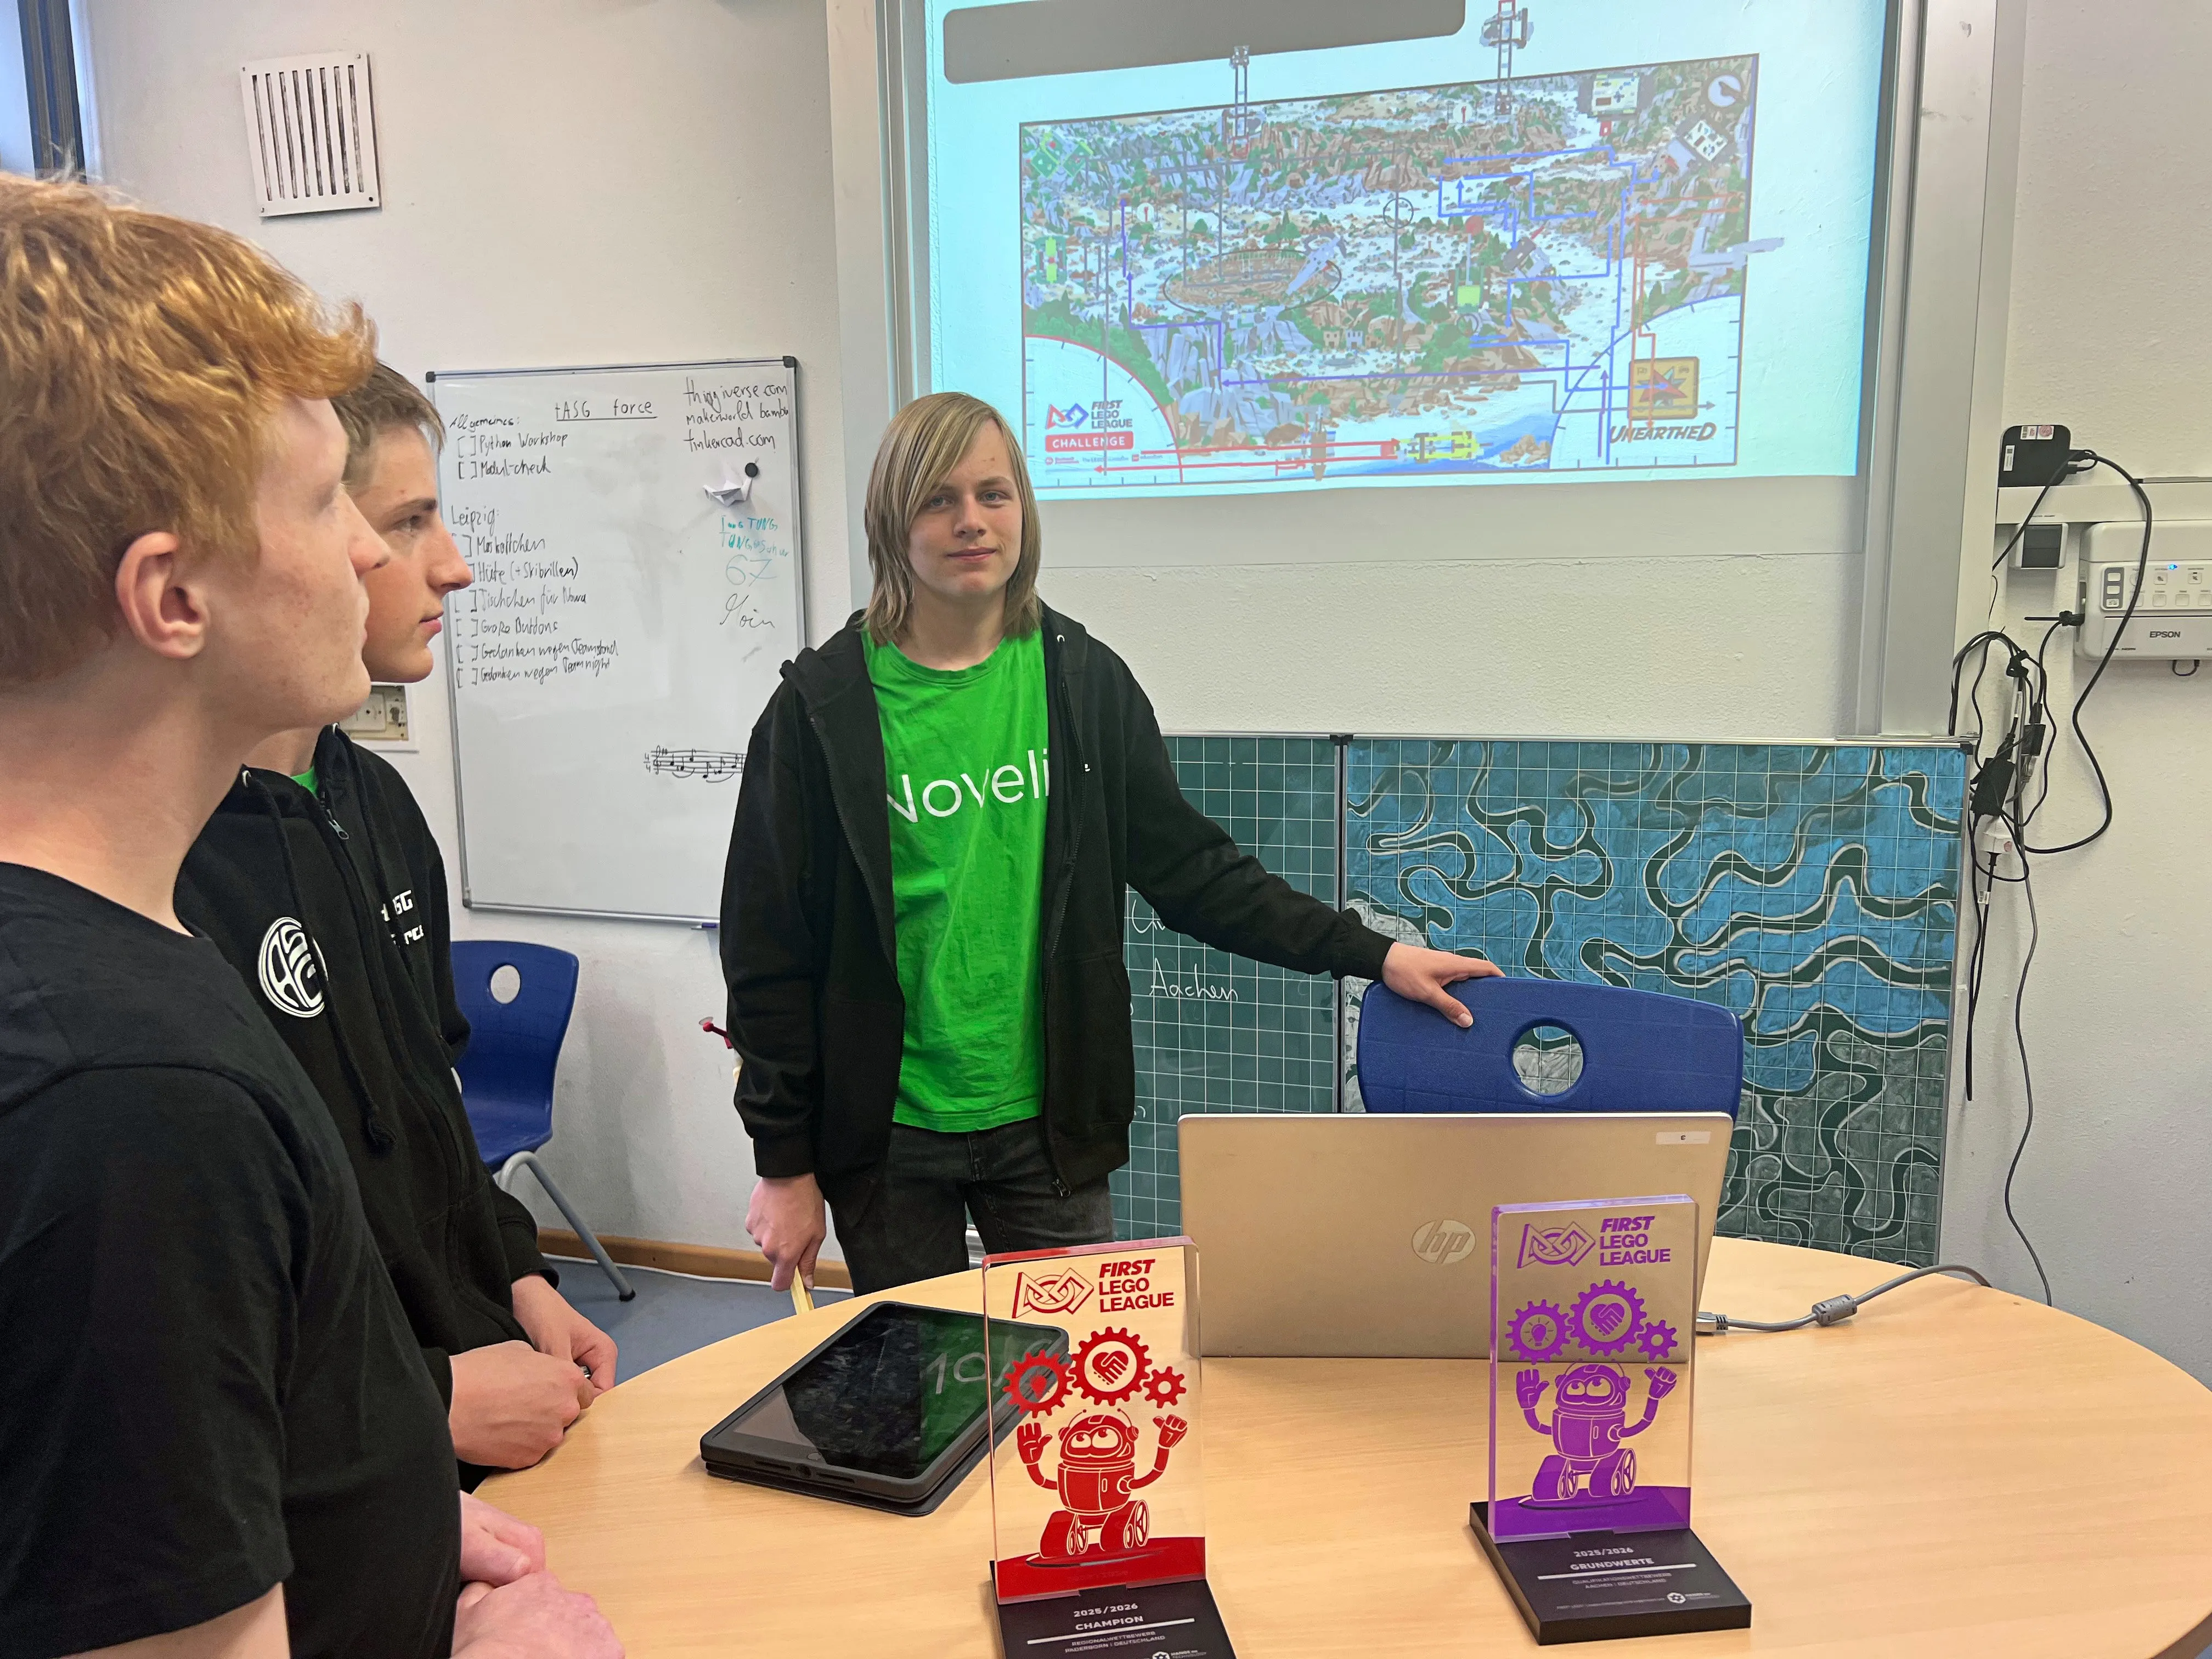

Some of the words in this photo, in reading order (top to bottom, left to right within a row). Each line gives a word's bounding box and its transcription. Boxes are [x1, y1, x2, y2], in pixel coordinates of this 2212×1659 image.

[614, 398, 653, 416] force
[1091, 399, 1123, 410] FIRST
[1091, 410, 1120, 420] LEGO
[1091, 419, 1133, 430] LEAGUE
[1610, 422, 1717, 444] UNEARTHED
[1052, 436, 1126, 449] CHALLENGE
[725, 554, 777, 588] 67
[887, 748, 1049, 823] Noveli
[1149, 957, 1238, 1002] Aachen
[1600, 1215, 1655, 1233] FIRST
[1417, 1220, 1471, 1263] hp
[1600, 1233, 1648, 1250] LEGO
[1600, 1248, 1671, 1266] LEAGUE
[1098, 1259, 1156, 1278] FIRST
[1099, 1278, 1150, 1296] LEGO
[1099, 1292, 1175, 1313] LEAGUE
[1573, 1547, 1635, 1558] 2025/2026
[1570, 1558, 1655, 1571] GRUNDWERTE
[1073, 1603, 1138, 1618] 2025/2026
[1075, 1615, 1144, 1630] CHAMPION
[1114, 1635, 1166, 1646] DEUTSCHLAND
